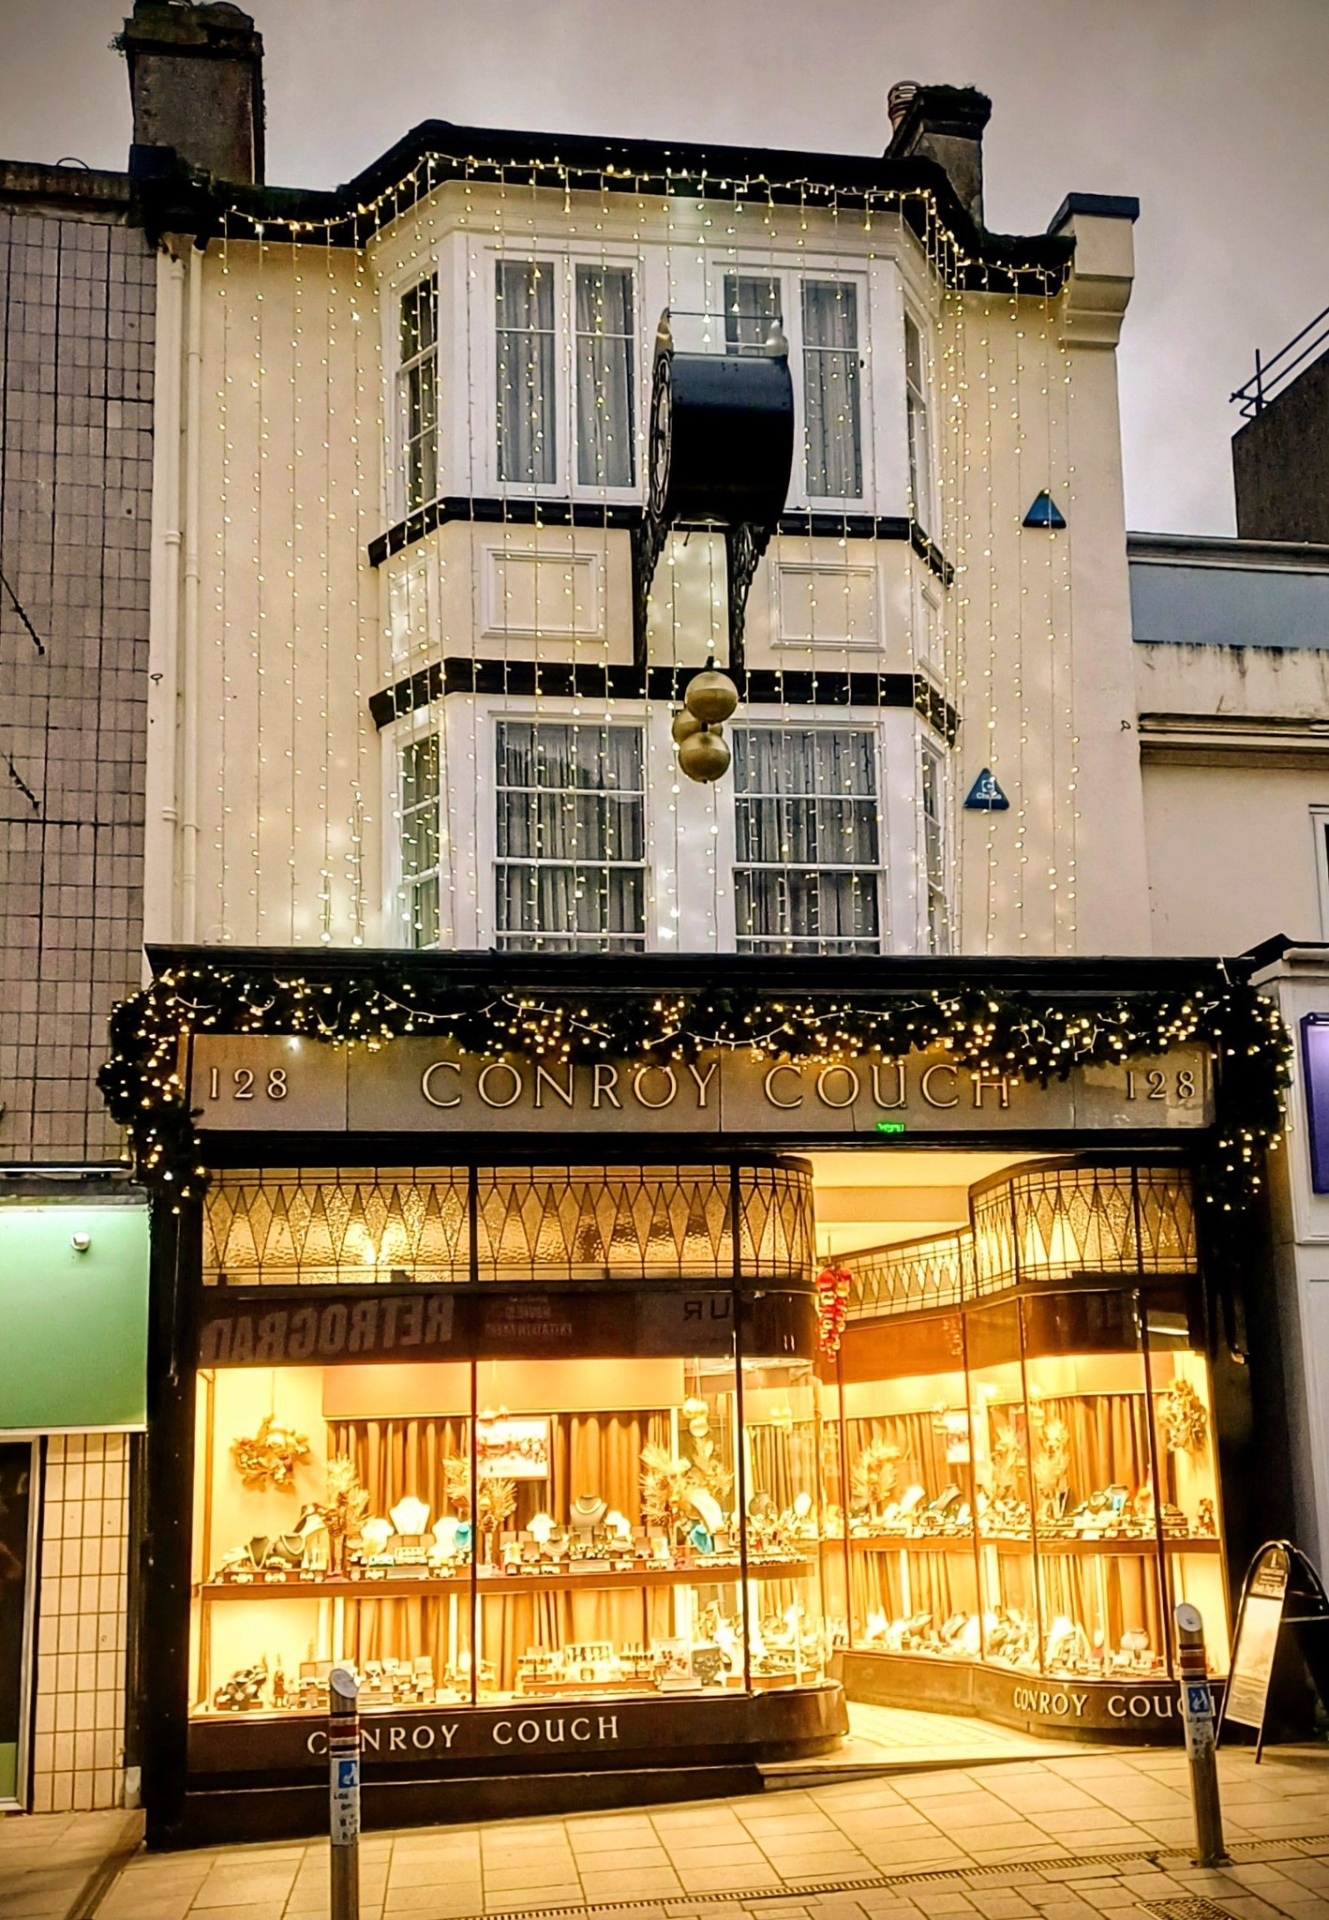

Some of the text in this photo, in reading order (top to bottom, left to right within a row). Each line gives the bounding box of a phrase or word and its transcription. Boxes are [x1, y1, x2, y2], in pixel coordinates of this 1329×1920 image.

[209, 1067, 288, 1099] 128
[421, 1061, 1011, 1109] CONROY COUCH
[1126, 1070, 1196, 1100] 128
[1013, 1686, 1089, 1717] CONROY
[306, 1716, 618, 1755] CNROY COUCH
